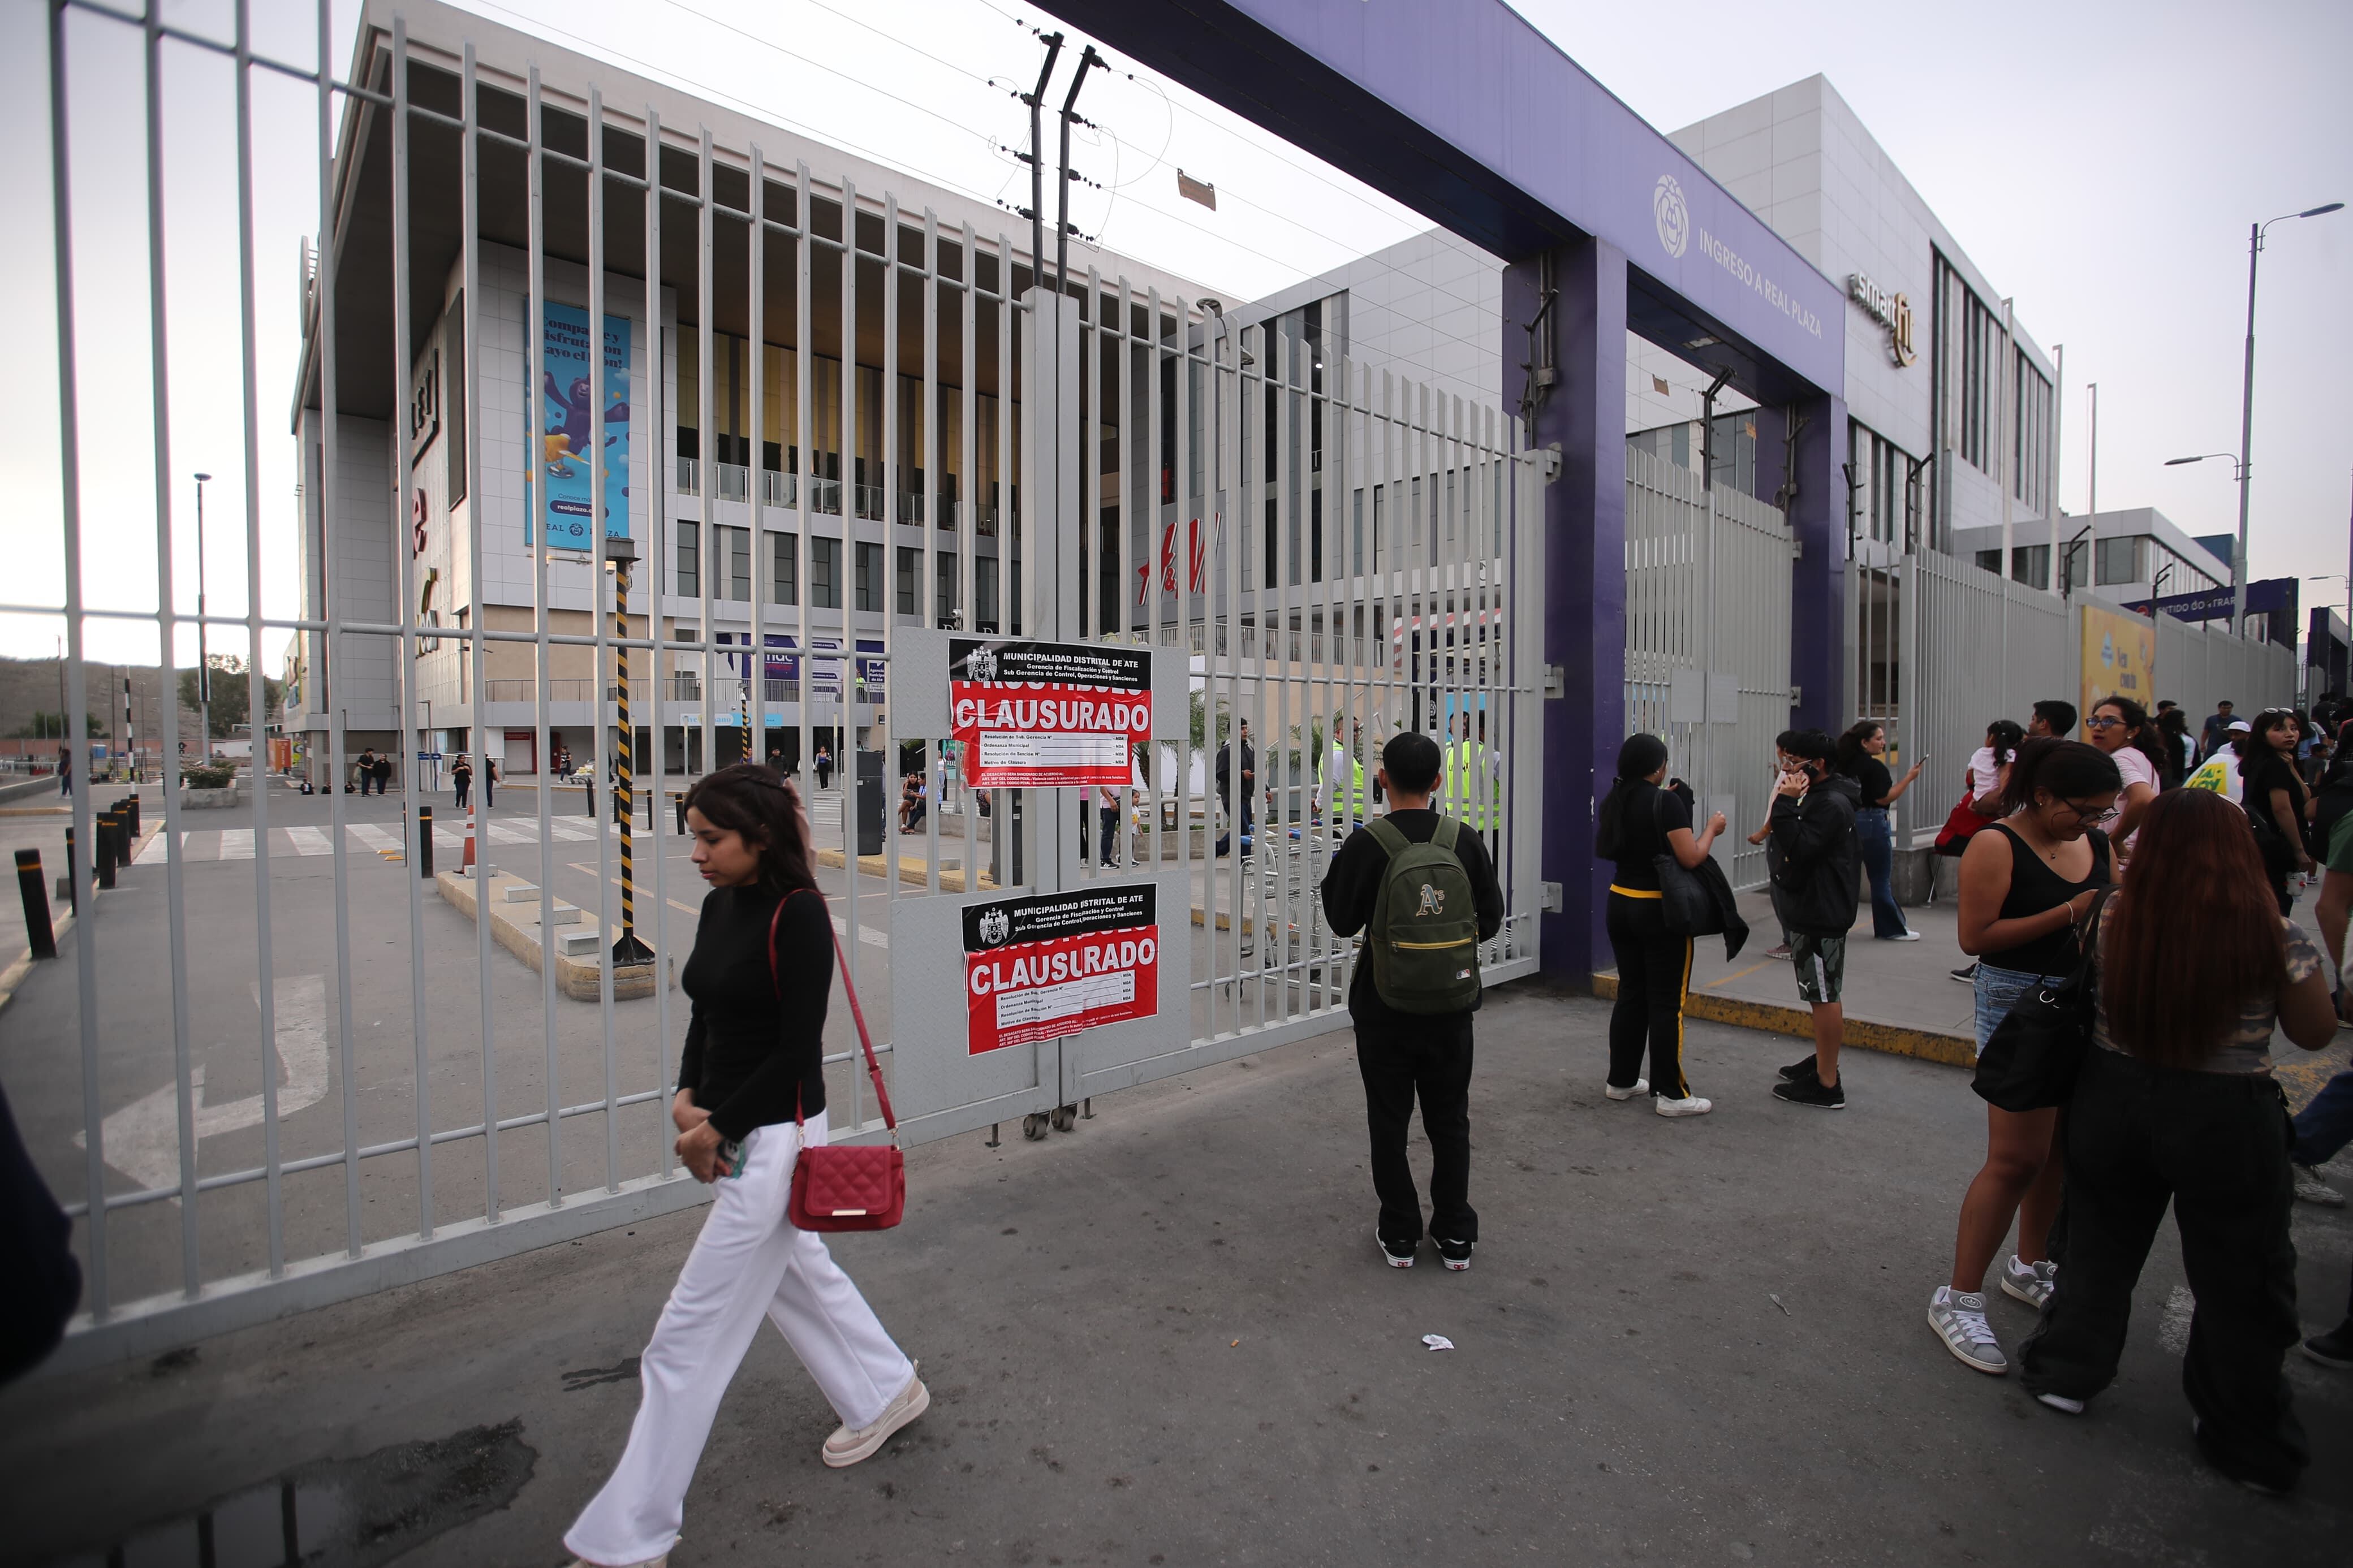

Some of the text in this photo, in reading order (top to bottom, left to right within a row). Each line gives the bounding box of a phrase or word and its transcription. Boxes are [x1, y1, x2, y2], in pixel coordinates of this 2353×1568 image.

[1700, 227, 1822, 339] INGRESO A REAL PLAZA
[546, 523, 564, 532] EAL
[1003, 653, 1072, 663] MUNICIPALIDAD
[1074, 656, 1110, 666] DISTRITAL
[956, 699, 1149, 732] CLAUSURADO
[1014, 902, 1078, 917] MUNICIPALIDAD
[1129, 895, 1144, 903] ATE
[1036, 914, 1061, 923] Gerencia
[971, 938, 1156, 996] CLAUSURADO
